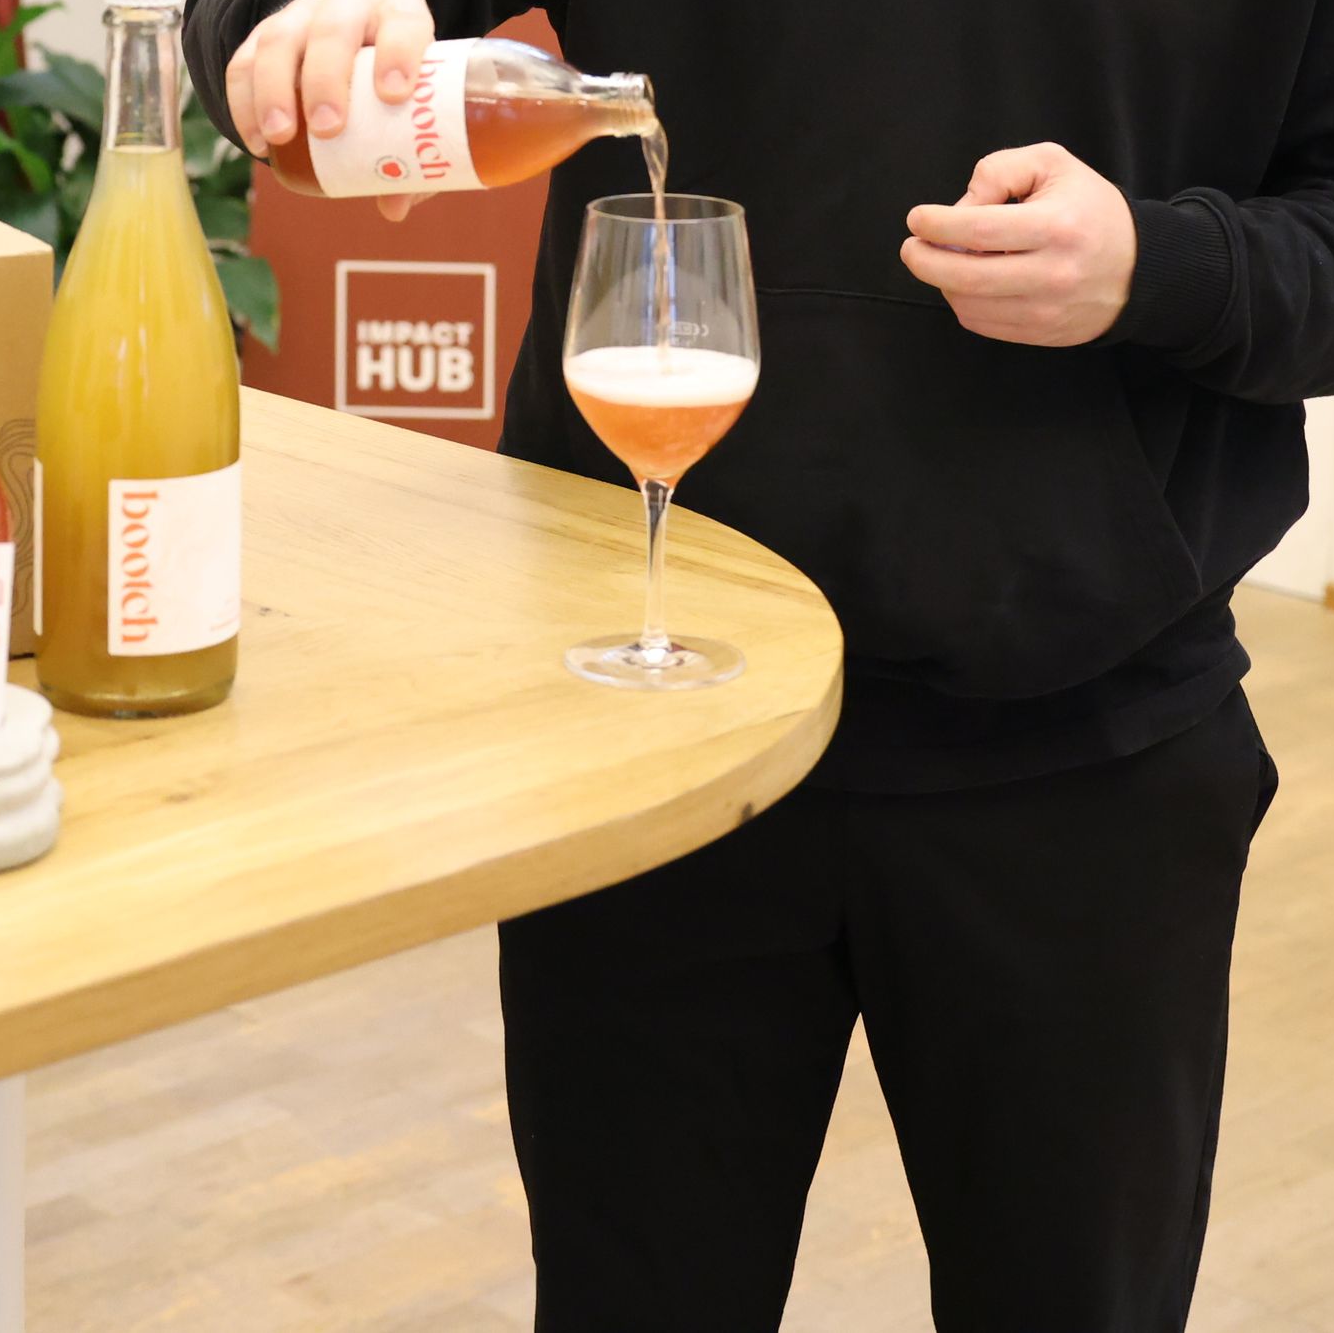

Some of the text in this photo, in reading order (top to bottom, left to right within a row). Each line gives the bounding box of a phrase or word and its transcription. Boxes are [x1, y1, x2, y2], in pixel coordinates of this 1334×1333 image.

[412, 59, 451, 179] bootch
[356, 320, 474, 346] IMPACT
[356, 344, 475, 393] HUB
[121, 490, 159, 644] bootch
